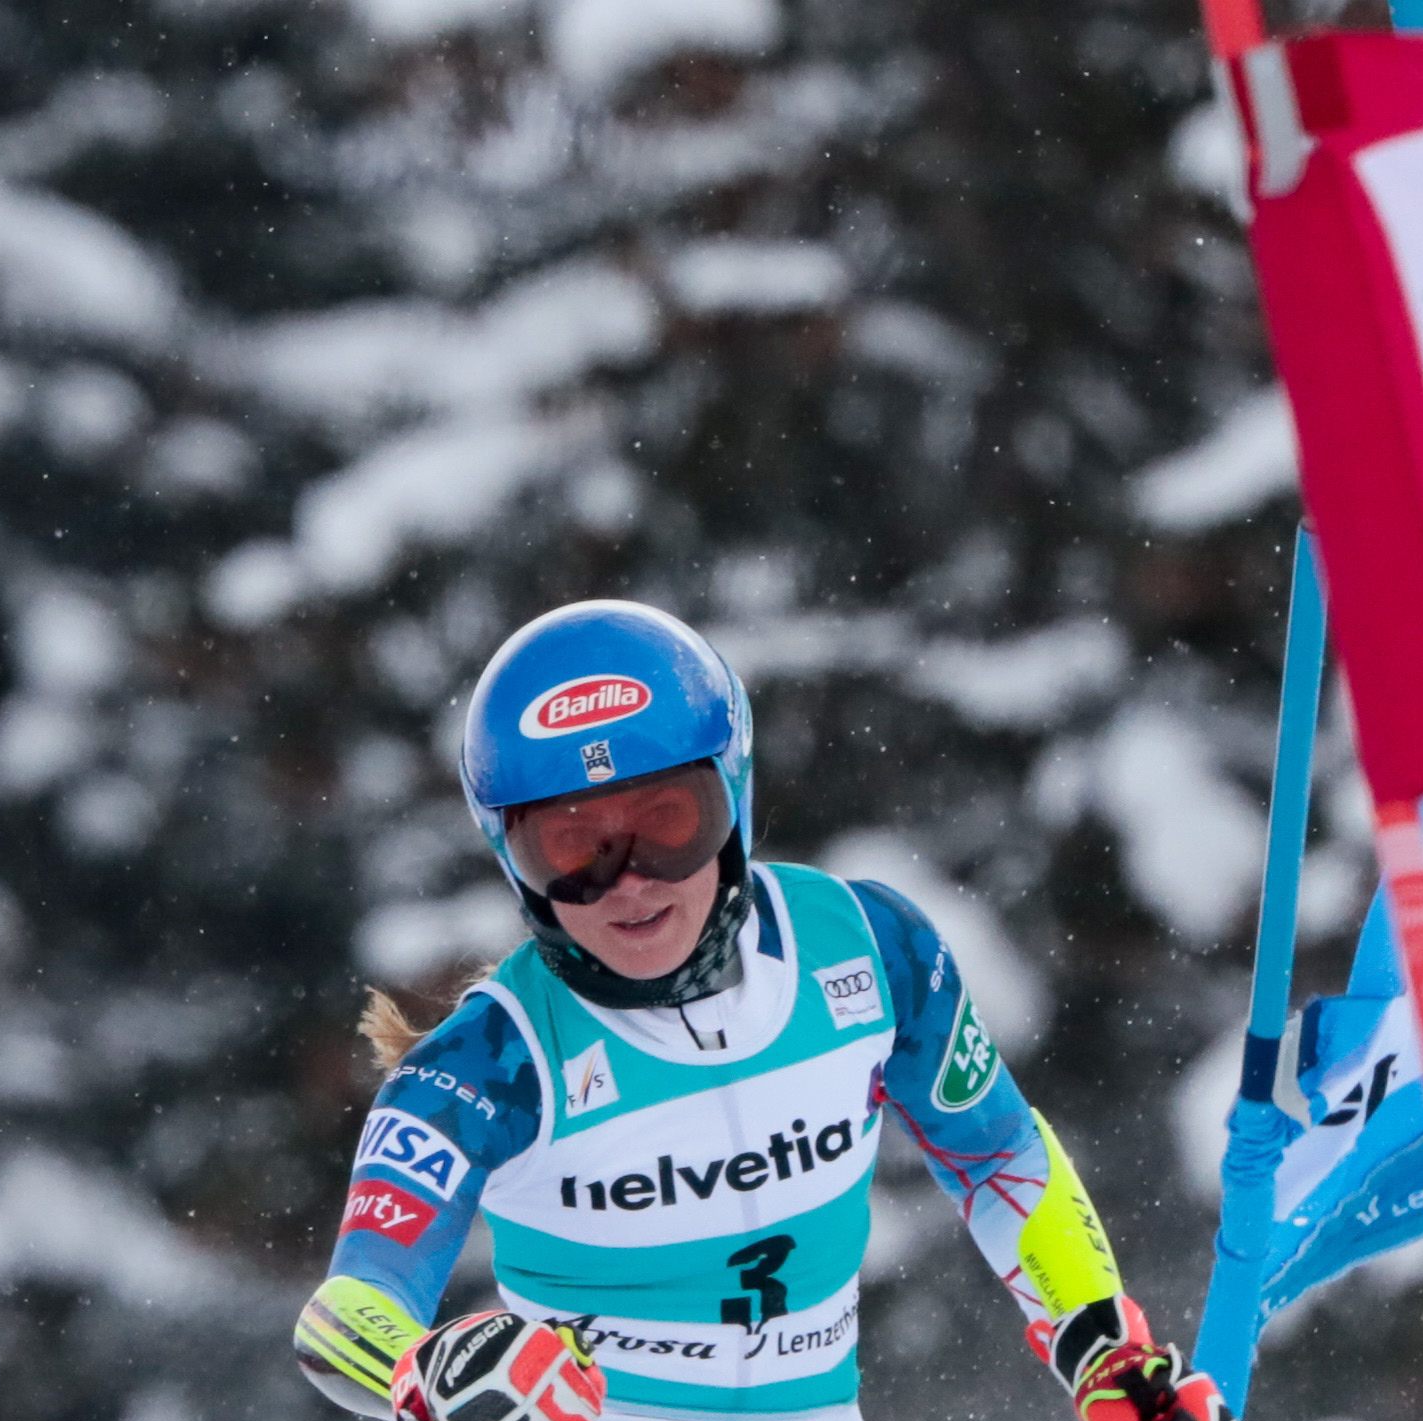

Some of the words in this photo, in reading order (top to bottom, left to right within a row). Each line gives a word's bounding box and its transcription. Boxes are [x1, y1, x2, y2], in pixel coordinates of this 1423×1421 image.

[547, 683, 640, 726] Barilla
[581, 742, 608, 761] US
[387, 1065, 497, 1121] SPYDER
[358, 1114, 456, 1193] VISA
[720, 1234, 798, 1326] 3
[356, 1306, 409, 1342] LEKI
[444, 1313, 515, 1389] reusch
